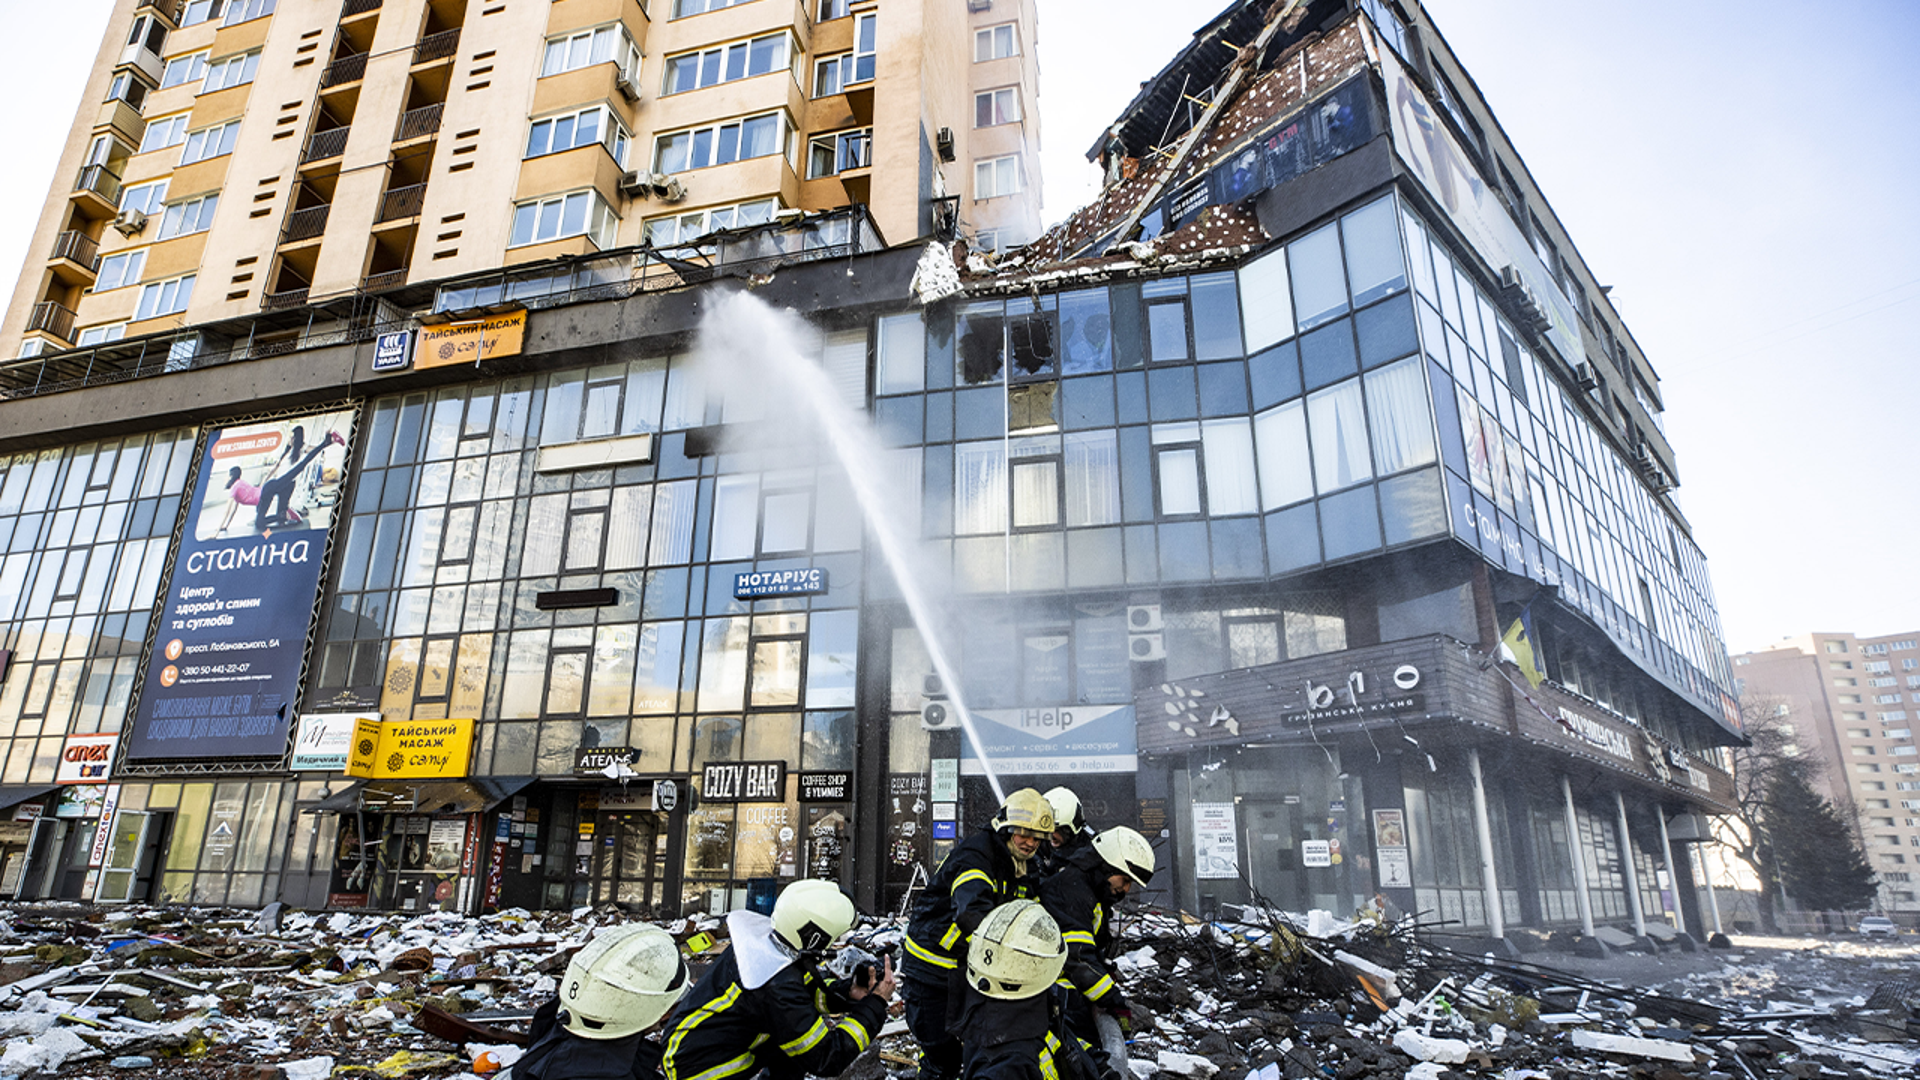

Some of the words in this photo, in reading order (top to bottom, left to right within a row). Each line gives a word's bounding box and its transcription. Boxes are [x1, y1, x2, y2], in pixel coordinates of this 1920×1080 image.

[1268, 123, 1298, 150] GYM
[423, 322, 478, 341] ТАЙСЬКИЙ
[481, 317, 521, 331] МАСАЖ
[377, 356, 401, 366] YARA
[738, 569, 820, 587] НОТАРІУС
[180, 586, 215, 600] Центр
[174, 598, 224, 616] здоров'я
[225, 597, 262, 610] спини
[172, 620, 184, 630] та
[186, 613, 234, 631] суглобів
[1020, 707, 1073, 730] iHelp
[392, 724, 457, 738] ТАЙСЬКИЙ
[399, 738, 444, 748] МАСАЖ
[64, 744, 111, 762] anex
[79, 763, 107, 777] tour
[704, 765, 744, 798] COZY
[746, 764, 779, 797] BAR
[802, 775, 828, 787] COFFEE
[828, 774, 847, 786] SHOP
[746, 807, 788, 824] COFFEE
[983, 949, 994, 966] 8
[569, 981, 580, 1000] 8
